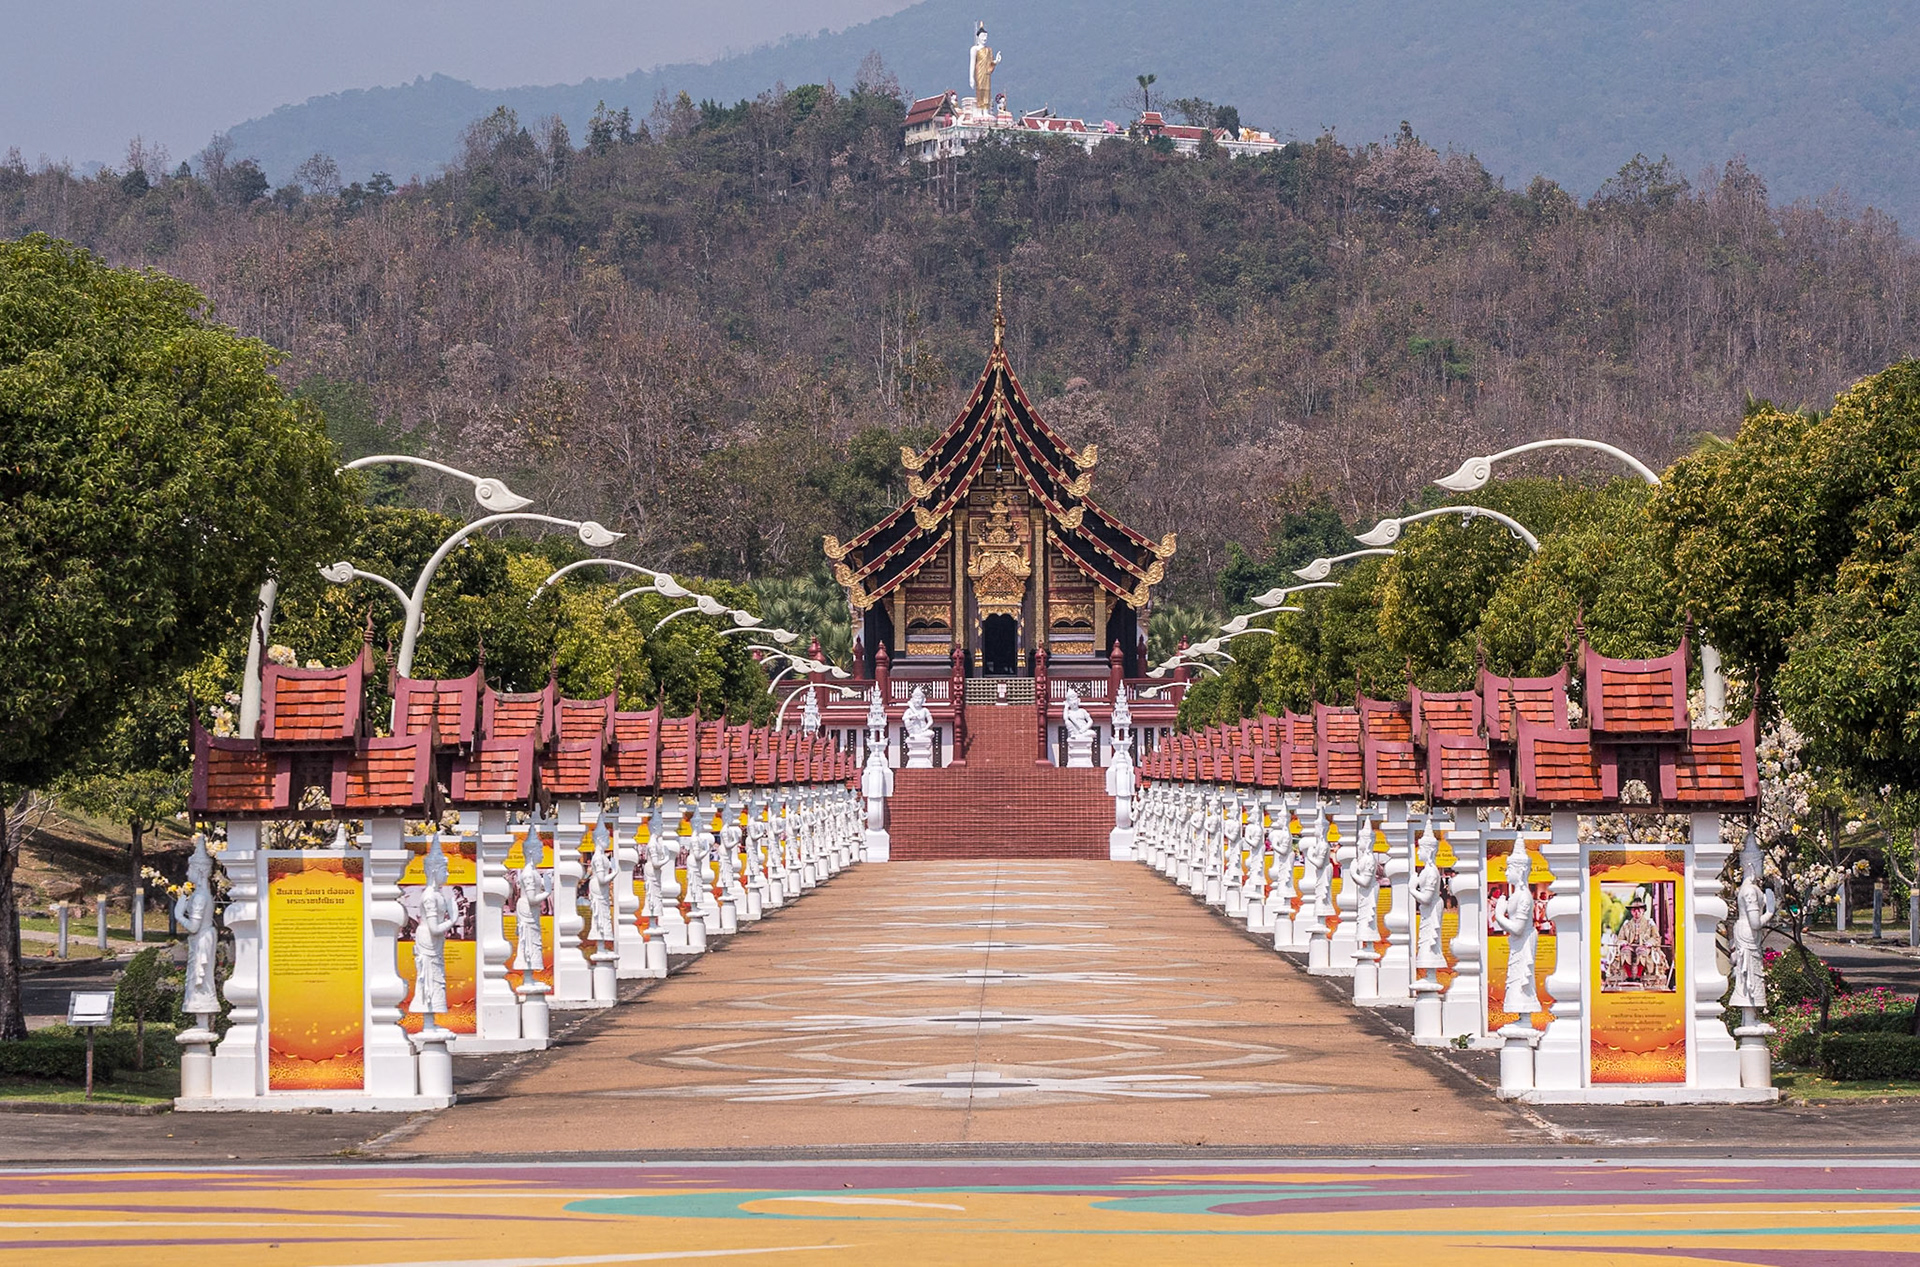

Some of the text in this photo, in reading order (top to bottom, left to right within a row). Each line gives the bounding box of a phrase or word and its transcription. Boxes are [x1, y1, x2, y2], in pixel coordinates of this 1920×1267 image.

[305, 887, 325, 895] รักษา
[327, 887, 355, 895] ต่อยอด
